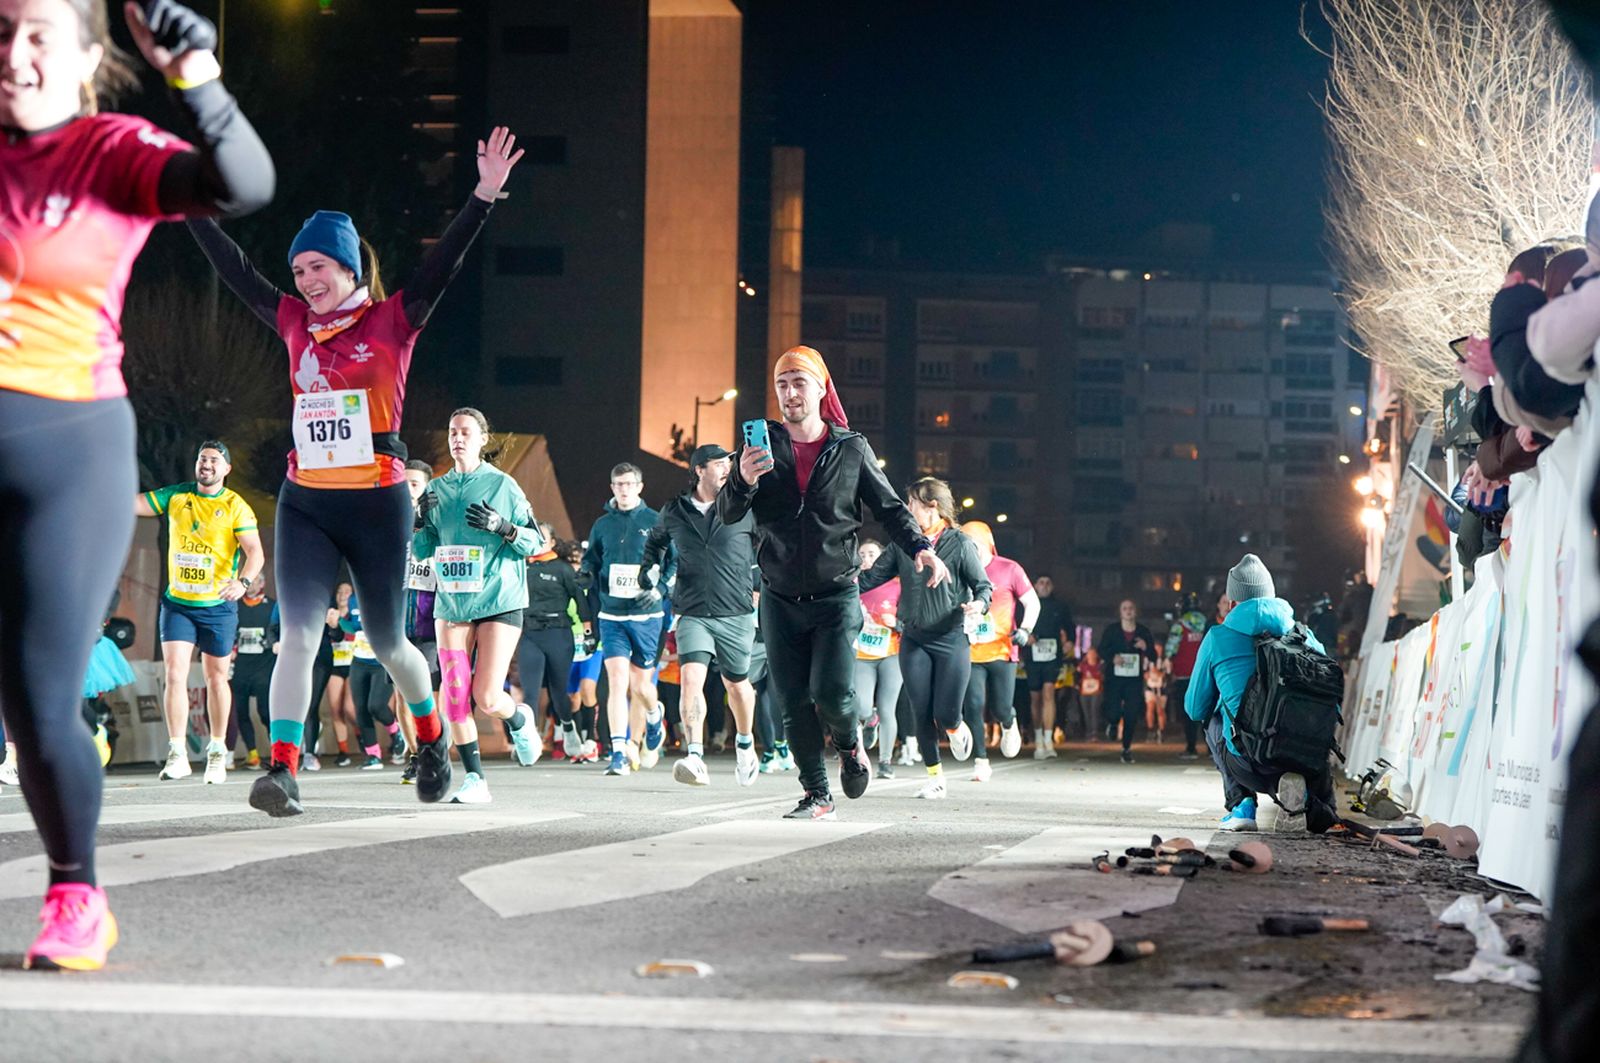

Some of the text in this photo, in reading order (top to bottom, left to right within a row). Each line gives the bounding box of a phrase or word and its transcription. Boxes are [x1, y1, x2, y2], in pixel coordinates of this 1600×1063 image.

[307, 418, 352, 443] 1376
[179, 566, 206, 581] 7639
[442, 562, 473, 577] 3081
[861, 632, 884, 646] 9027
